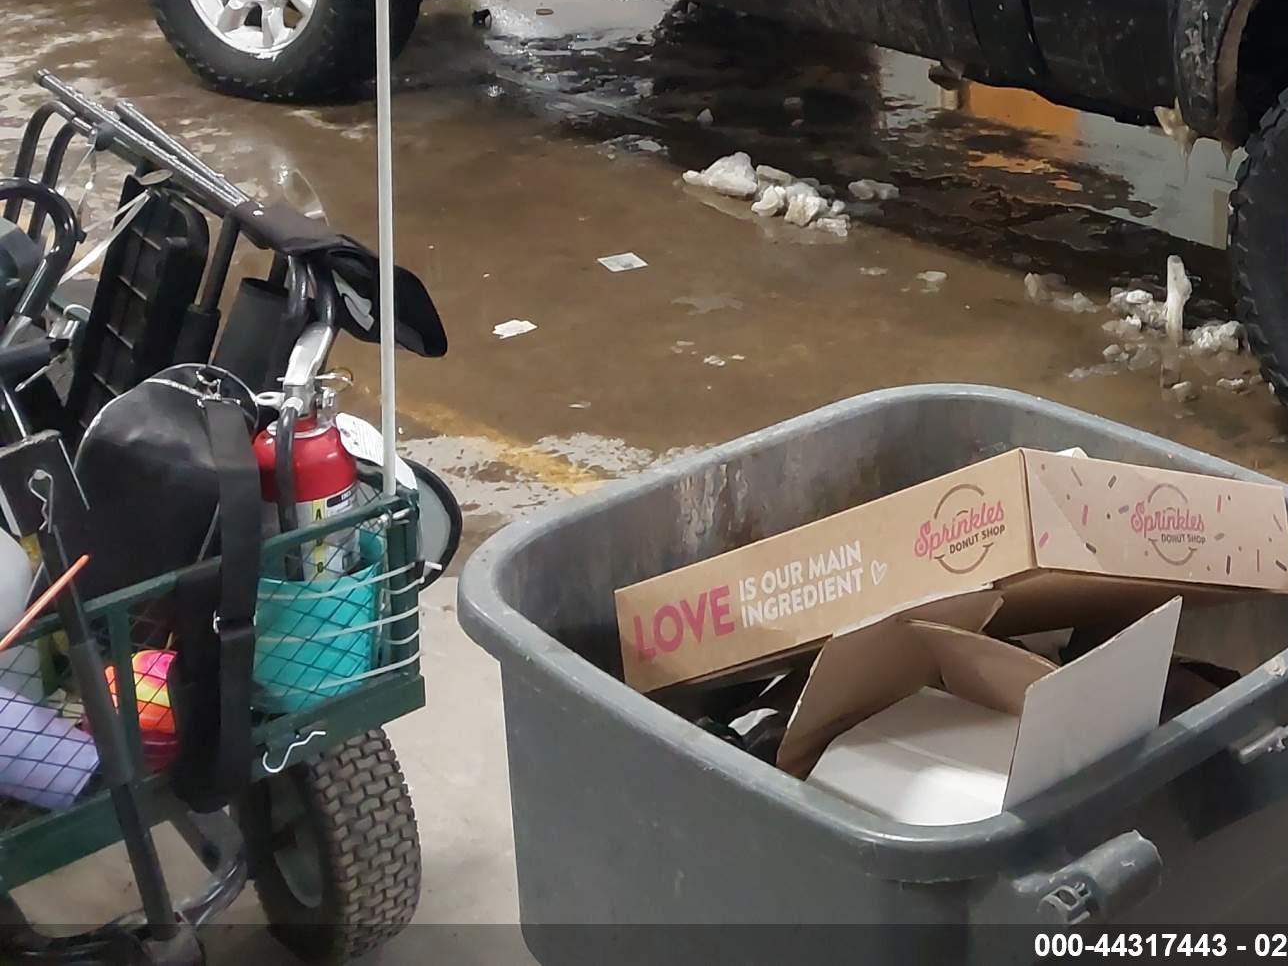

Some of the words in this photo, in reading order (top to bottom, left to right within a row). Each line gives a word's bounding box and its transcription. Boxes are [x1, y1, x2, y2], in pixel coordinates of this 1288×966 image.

[914, 499, 1004, 560] Sprinkles
[949, 533, 979, 554] DONUT
[981, 524, 1005, 540] SHOP
[1130, 500, 1204, 538] Sprinkles
[1161, 533, 1185, 544] DONUT
[1187, 534, 1206, 545] SHOP
[738, 577, 755, 602] IS
[762, 560, 804, 595] OUR
[808, 540, 862, 581] MAIN
[741, 568, 863, 628] INGREDIENT
[633, 584, 735, 660] LOVE
